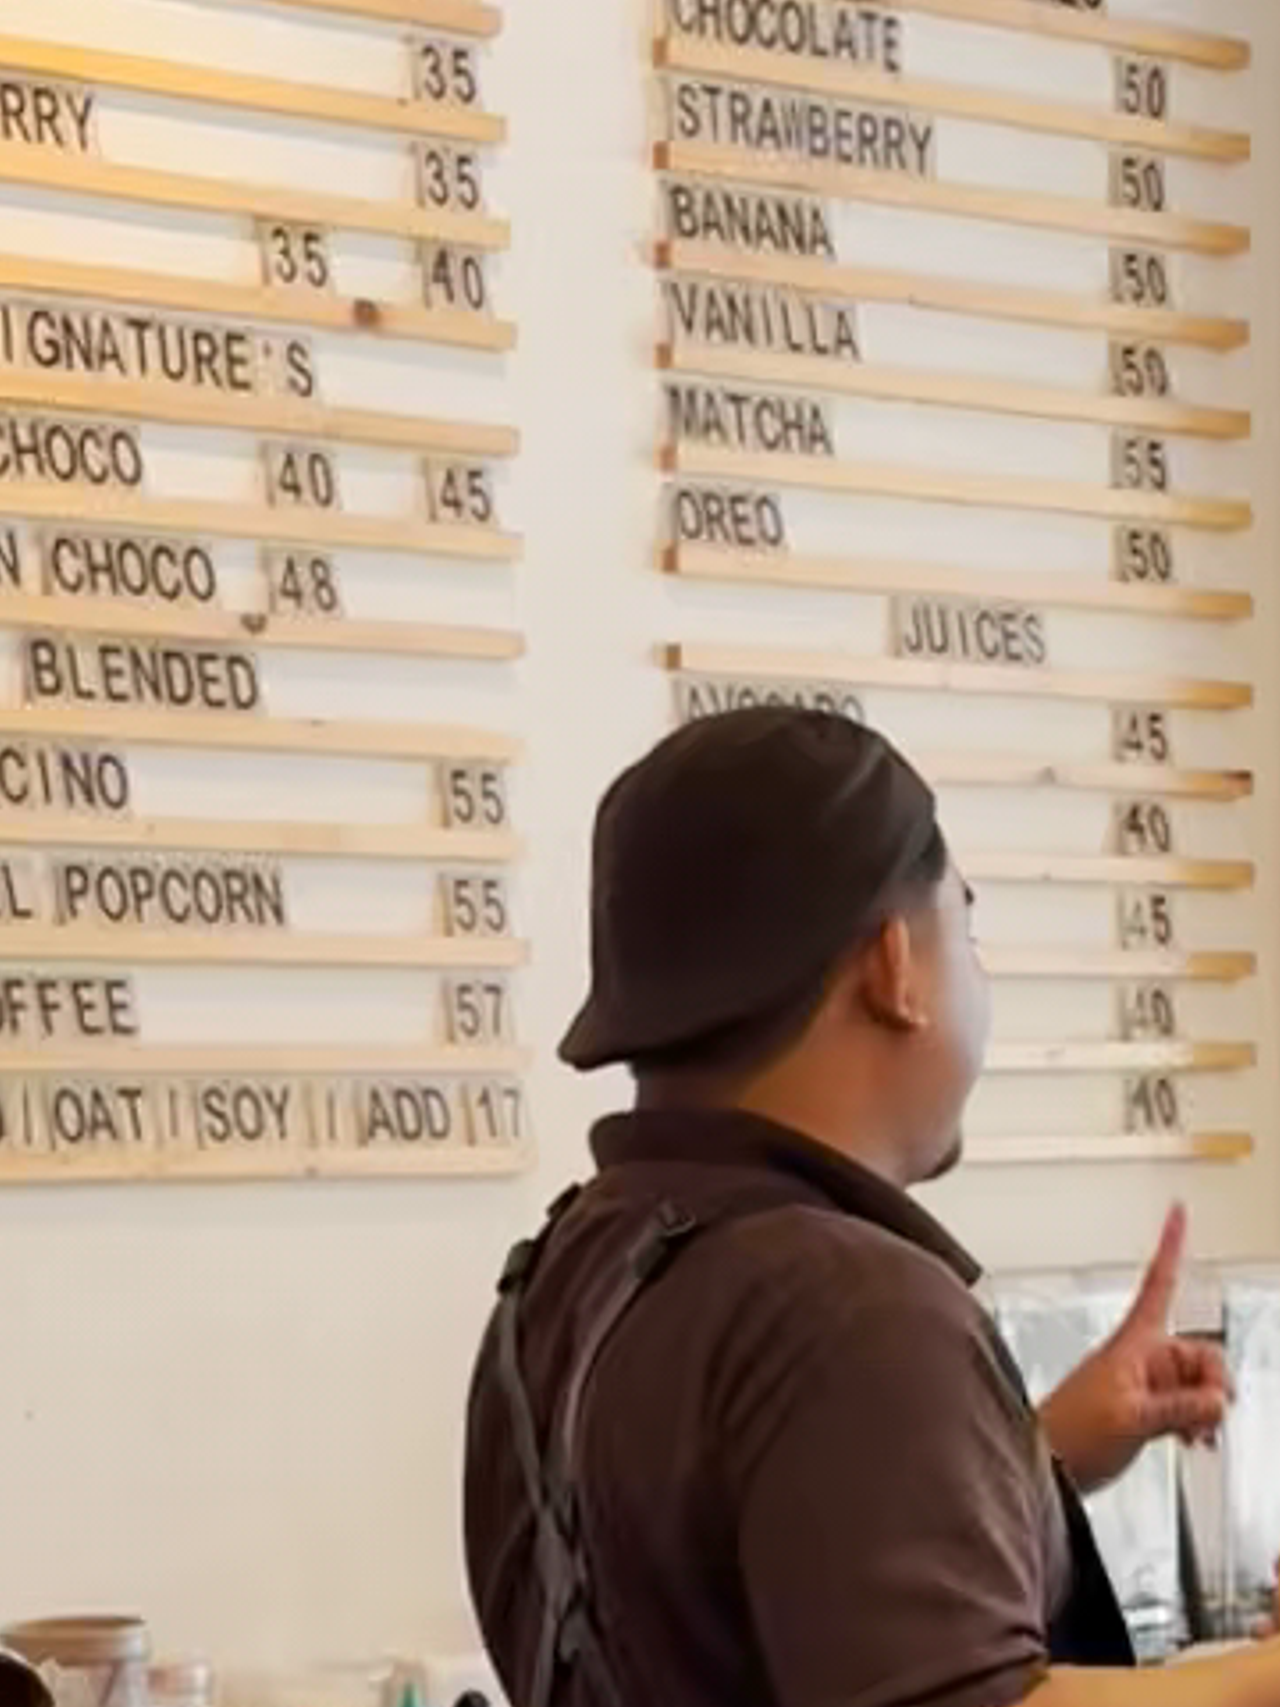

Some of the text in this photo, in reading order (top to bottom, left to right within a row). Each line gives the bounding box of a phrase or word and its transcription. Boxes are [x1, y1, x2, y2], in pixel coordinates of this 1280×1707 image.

[421, 44, 477, 106] 35
[1123, 64, 1165, 117] 50
[424, 151, 481, 212] 35
[676, 85, 1165, 211] STRAWBERRY 50
[271, 228, 329, 287] 35
[431, 251, 484, 312] 40
[670, 184, 1166, 304] BANANA 50
[671, 282, 1168, 396] VANILLA 50
[666, 386, 1167, 491] MATCHA 55
[277, 452, 336, 507] 40
[436, 469, 492, 521] 45
[679, 490, 1171, 582] OREO 50
[51, 536, 216, 601] CHOCO
[279, 557, 338, 613] 48
[903, 611, 1047, 664] JUICES
[30, 638, 258, 711] BLENDED
[1122, 712, 1168, 761] 45
[450, 768, 506, 826] 55
[1124, 804, 1170, 854] 40
[65, 864, 286, 927] POPCORN
[452, 878, 507, 933] 55
[456, 983, 505, 1037] 57
[366, 1090, 451, 1142] ADD
